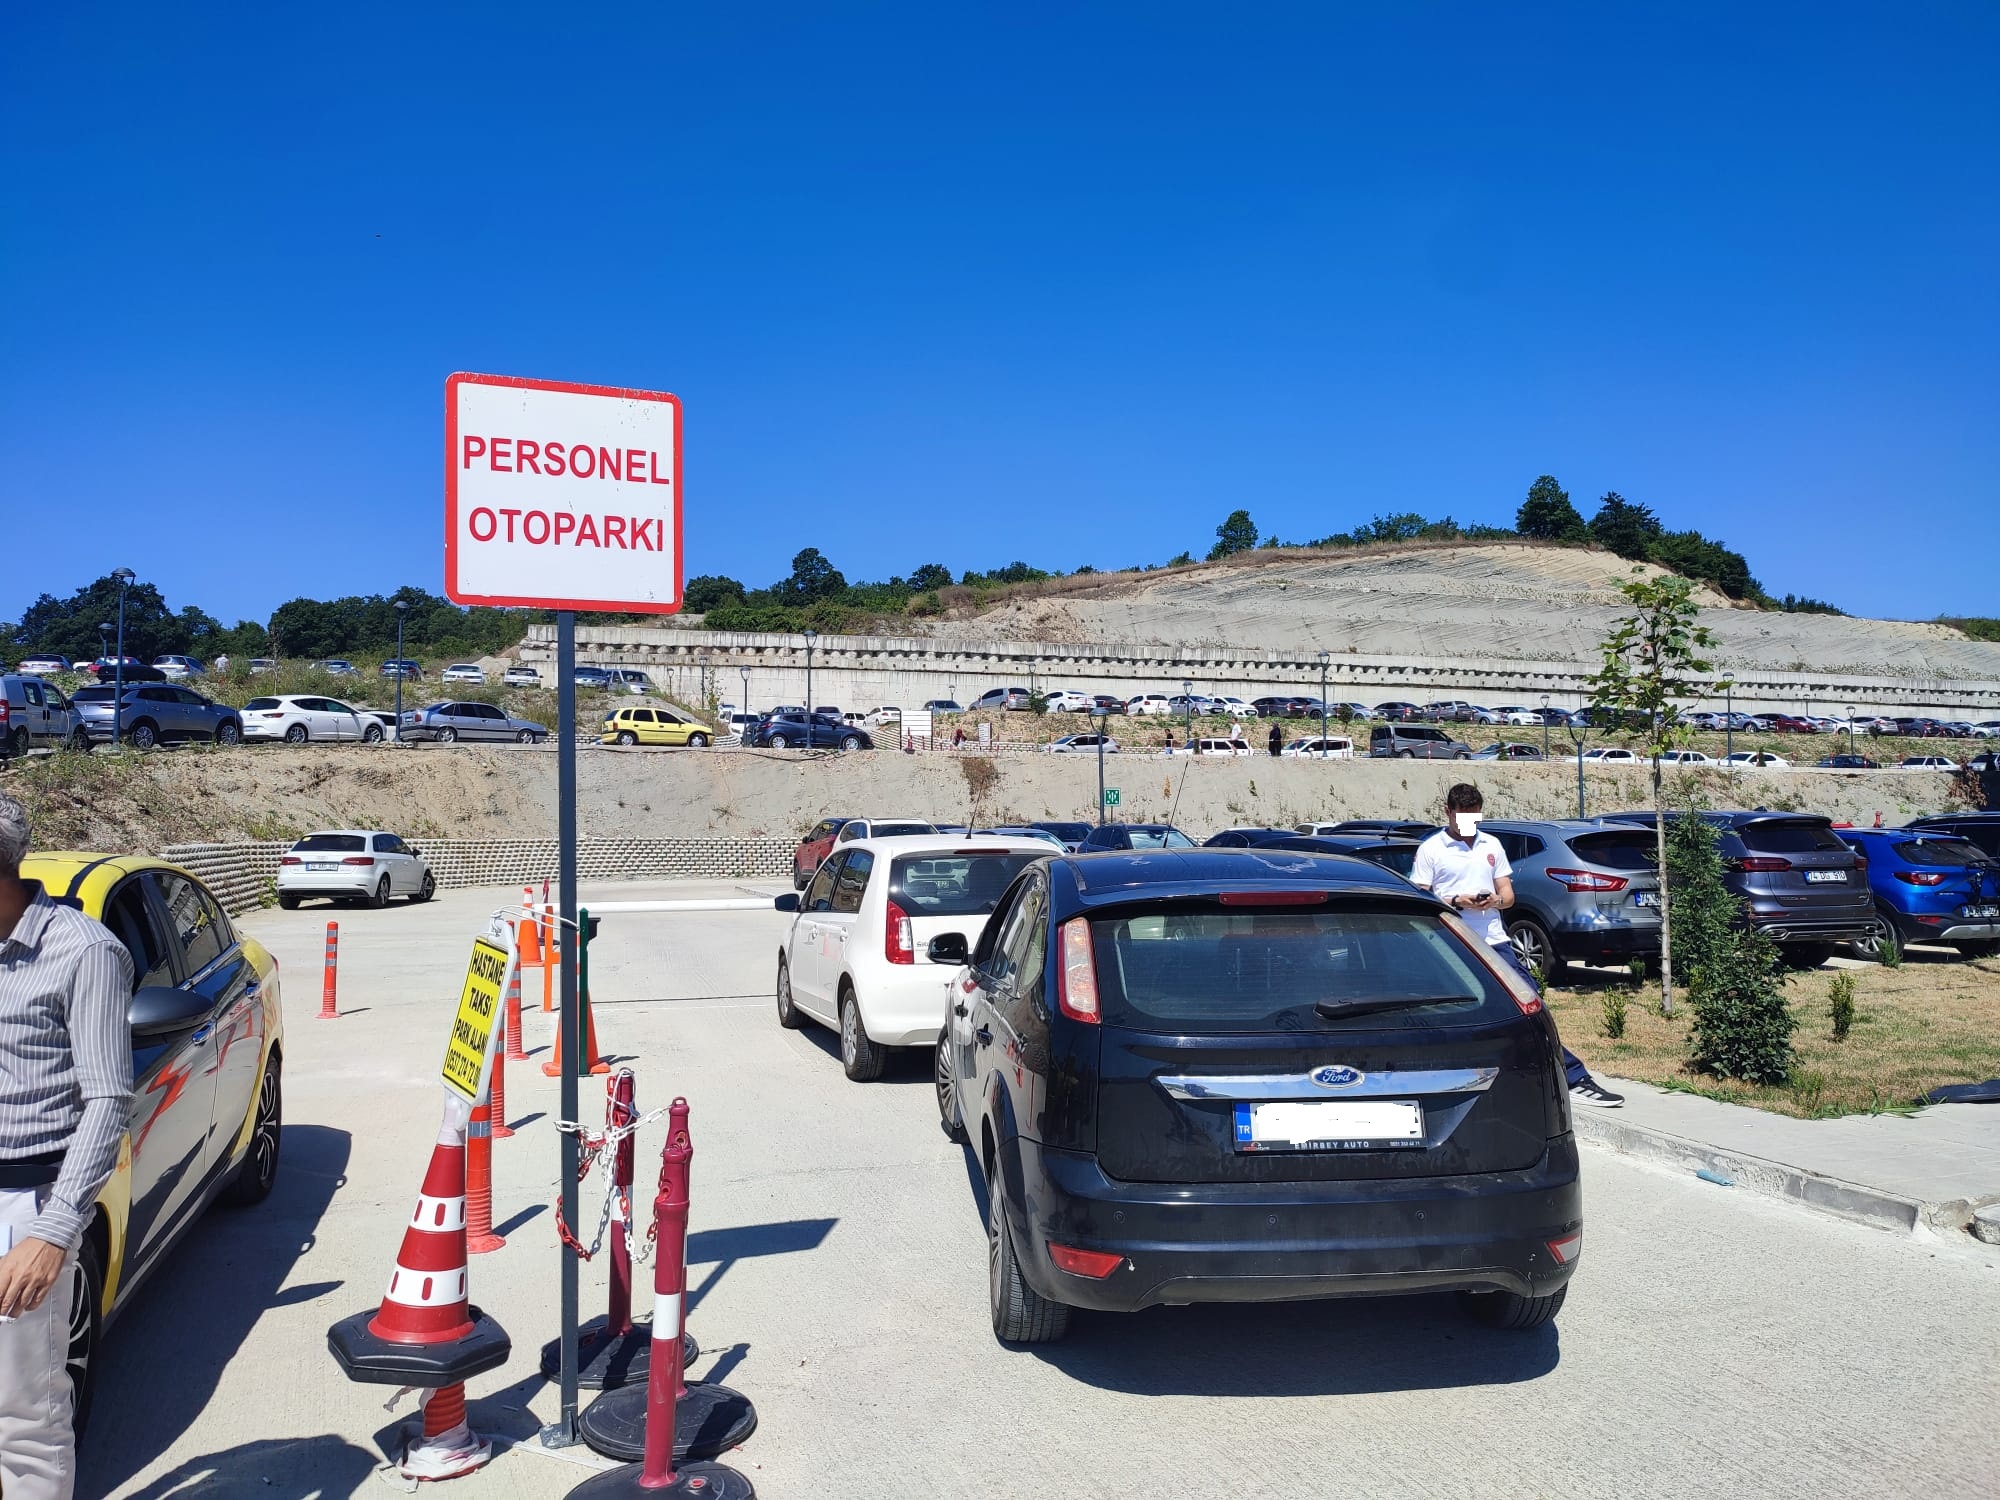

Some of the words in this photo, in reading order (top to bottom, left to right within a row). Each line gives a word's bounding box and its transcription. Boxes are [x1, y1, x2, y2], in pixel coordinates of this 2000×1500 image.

[463, 435, 670, 485] PERSONEL
[468, 506, 663, 552] OTOPARKI
[471, 950, 506, 987] HASTANE
[454, 1018, 472, 1046] PARK
[1322, 1069, 1351, 1082] Ford
[1237, 1124, 1250, 1135] TR
[1343, 1140, 1370, 1149] AUTO
